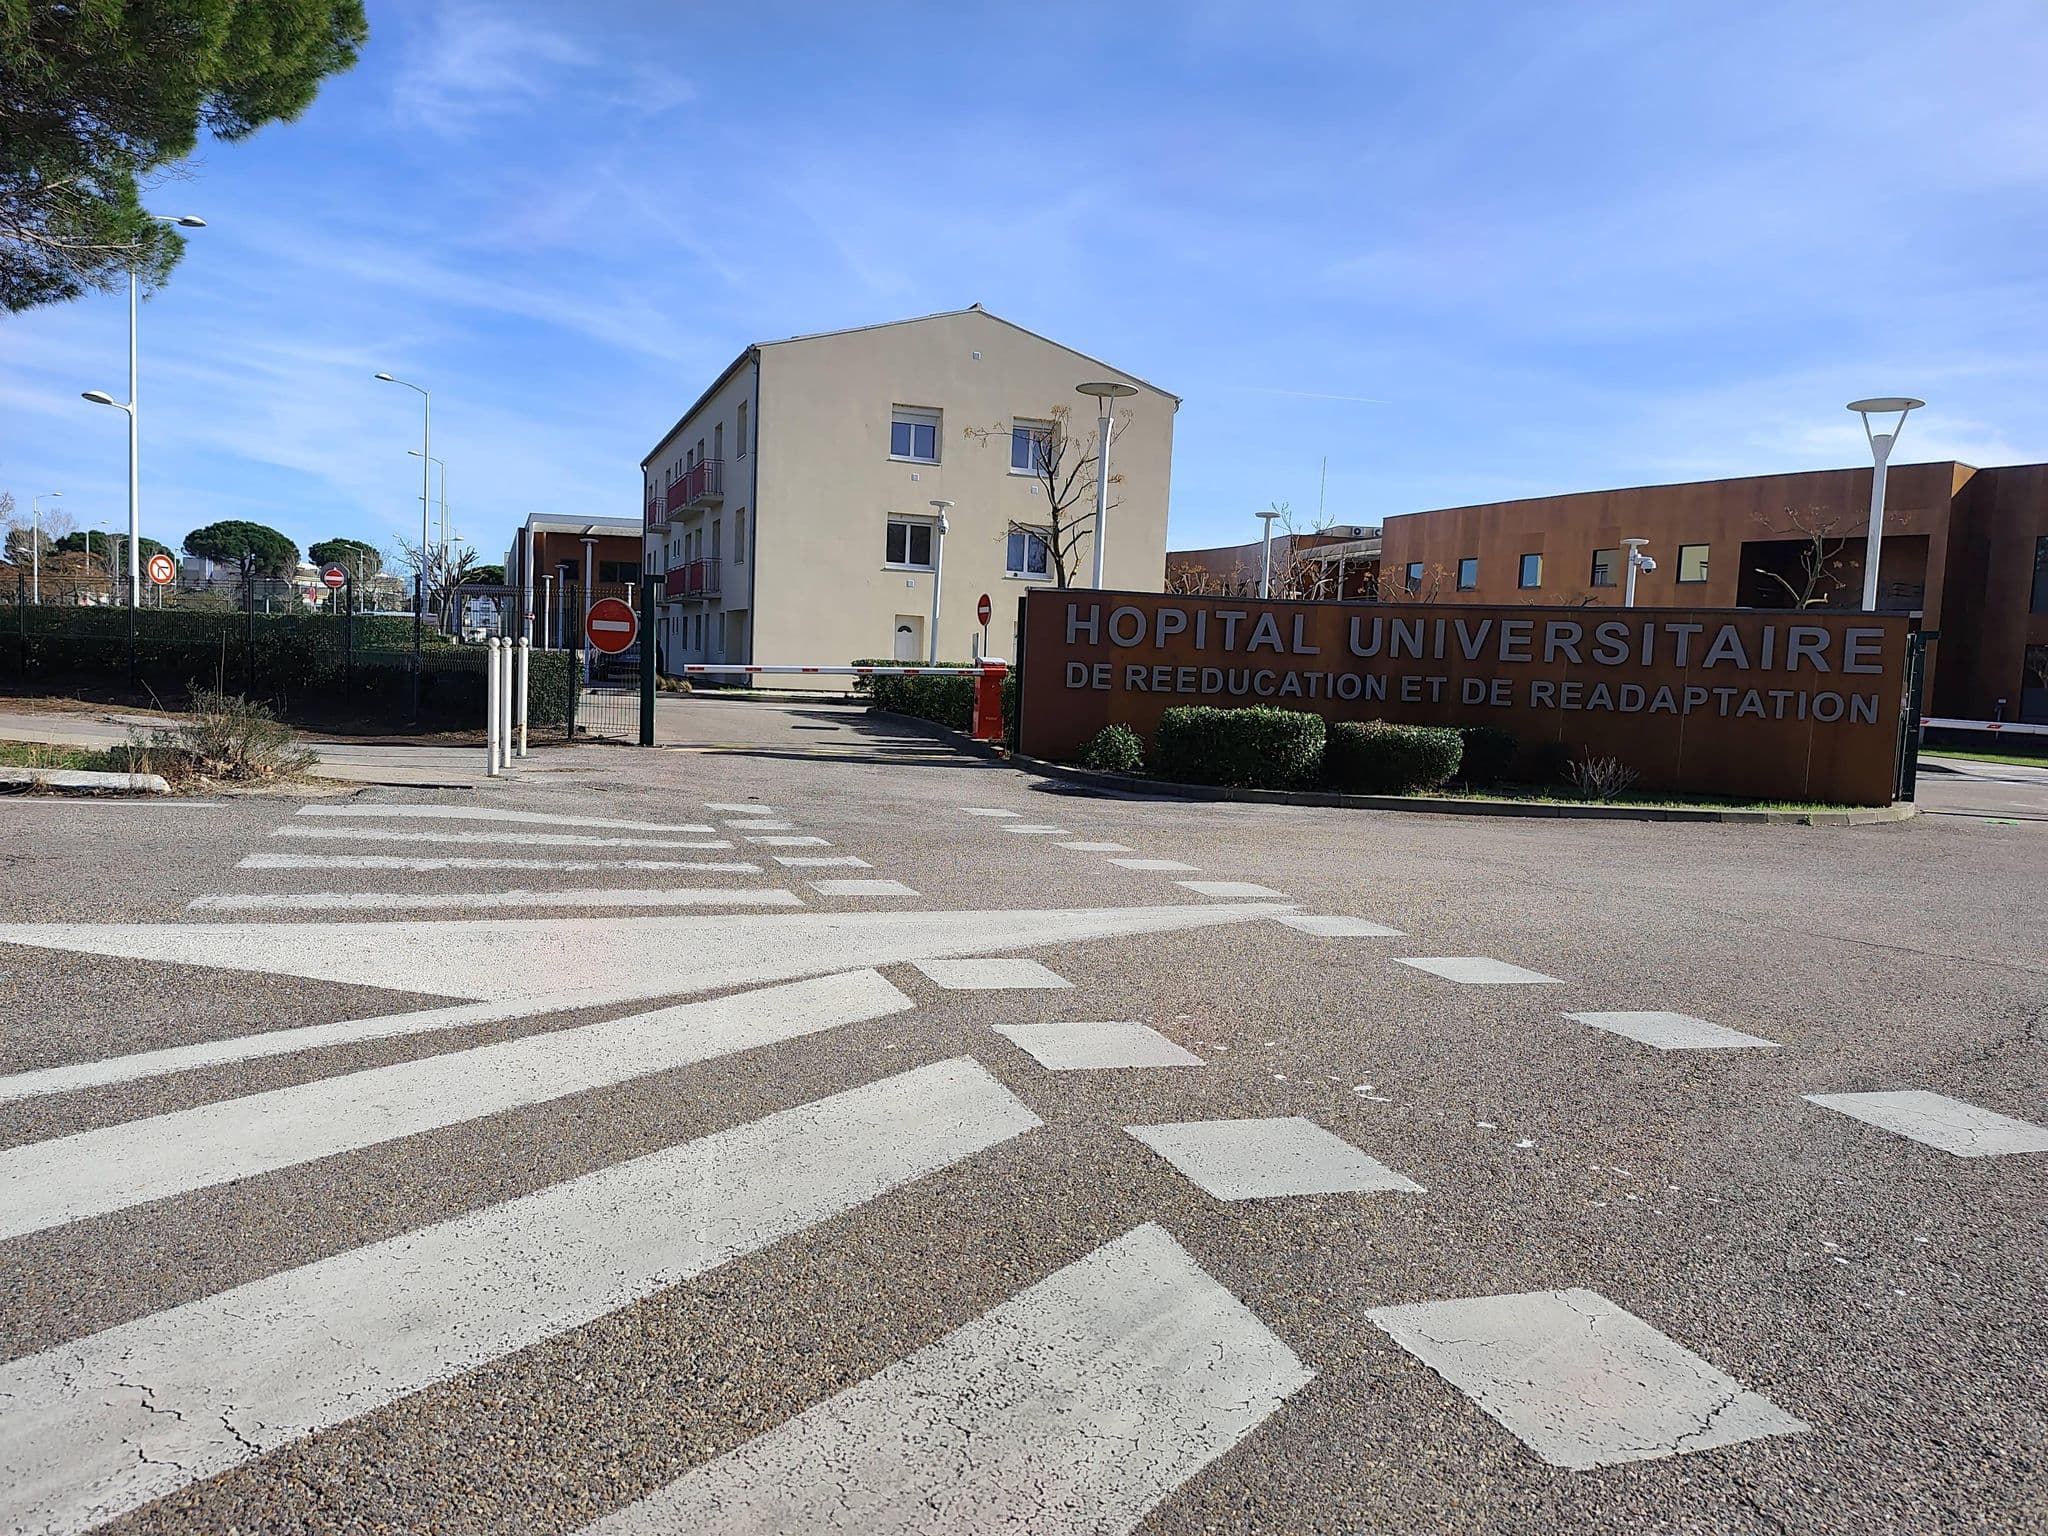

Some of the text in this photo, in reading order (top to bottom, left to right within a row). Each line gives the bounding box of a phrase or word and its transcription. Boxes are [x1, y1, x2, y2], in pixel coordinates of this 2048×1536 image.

[1065, 603, 1885, 674] HOPITAL UNIVERSITAIRE
[1065, 662, 1879, 724] DE REEDUCATION ET DE READAPTATION
